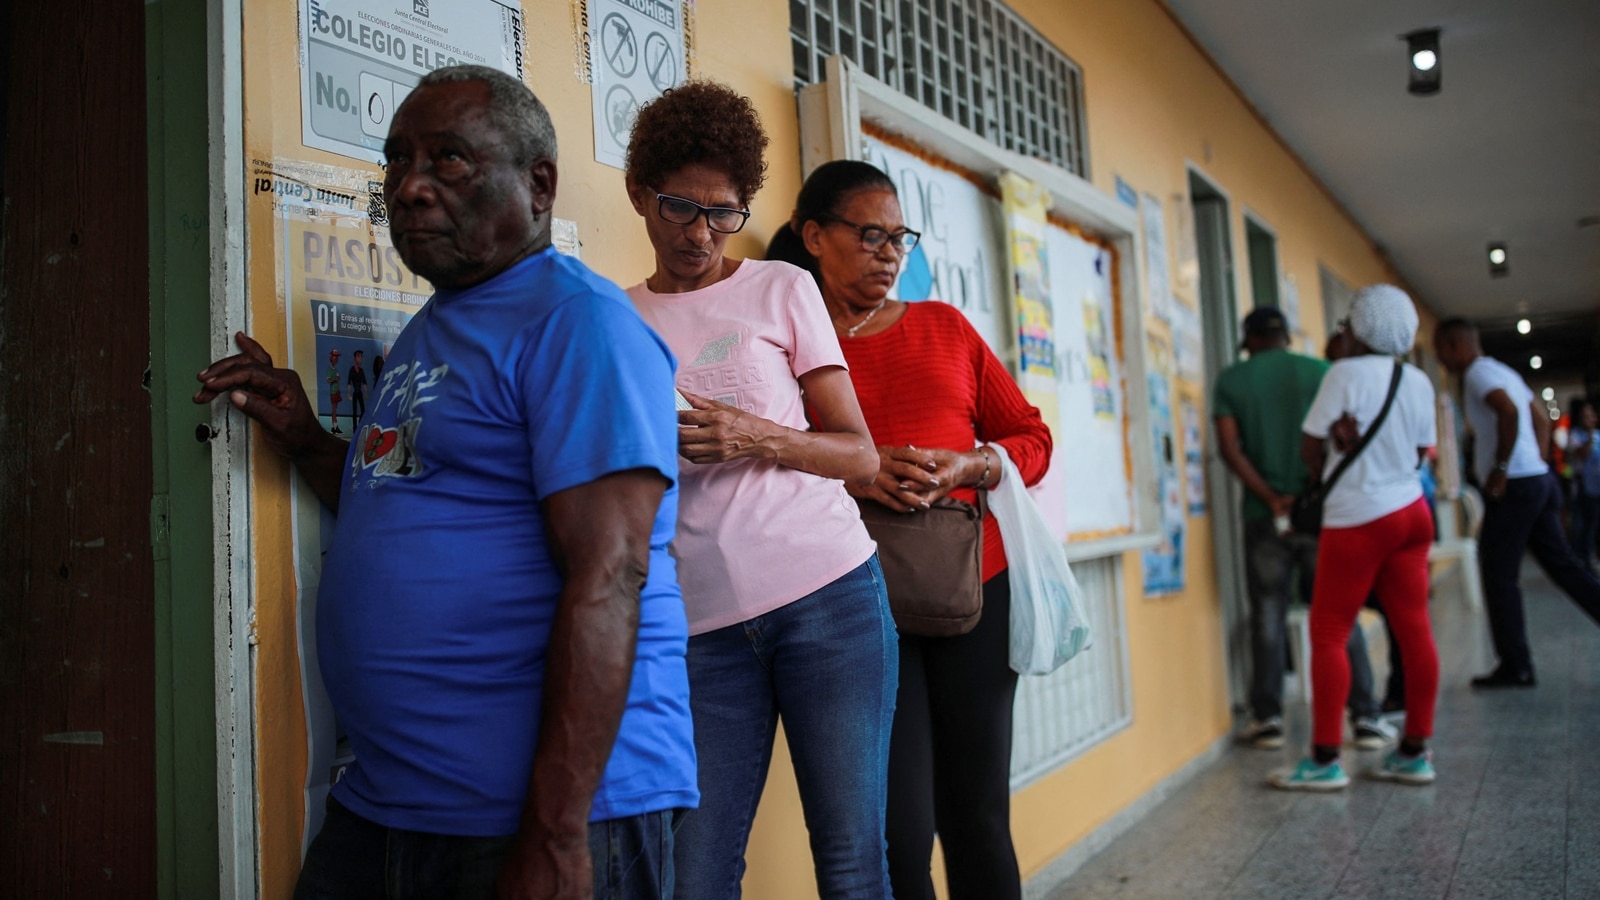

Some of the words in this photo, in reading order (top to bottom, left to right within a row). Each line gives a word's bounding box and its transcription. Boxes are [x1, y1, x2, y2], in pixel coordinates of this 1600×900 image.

[317, 10, 406, 60] COLEGIO
[358, 11, 390, 29] ELECCIONES
[390, 23, 422, 41] ORDINARIAS
[423, 36, 452, 52] GENERALES
[452, 46, 462, 56] DEL
[462, 50, 474, 59] AÑO
[394, 8, 408, 19] Junta
[409, 14, 427, 26] Central
[427, 20, 449, 34] Electoral
[315, 72, 358, 116] No.
[255, 178, 312, 202] Central
[303, 231, 404, 287] PASOS
[354, 286, 401, 302] ELECCIONES
[317, 303, 338, 333] 01
[341, 313, 357, 323] Entras
[347, 322, 367, 332] colegio
